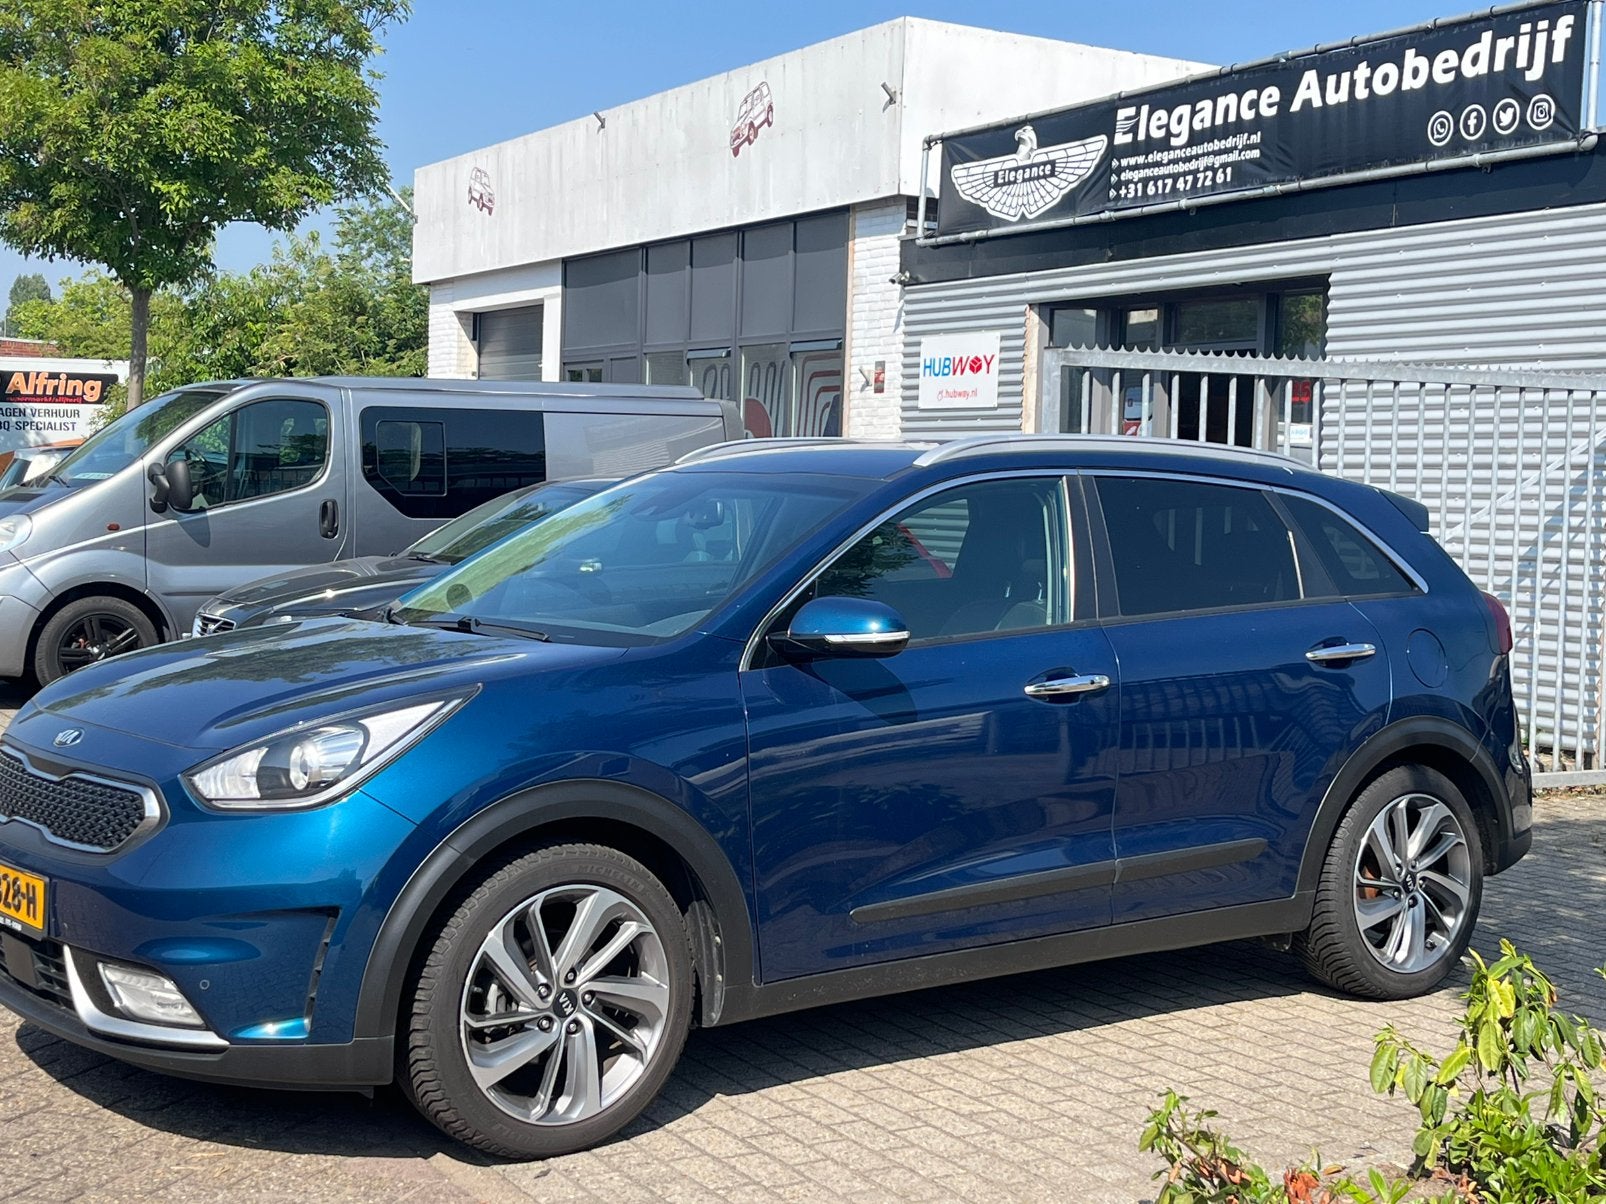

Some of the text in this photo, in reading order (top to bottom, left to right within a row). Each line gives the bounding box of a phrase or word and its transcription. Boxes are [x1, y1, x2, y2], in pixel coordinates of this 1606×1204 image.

[1114, 14, 1575, 146] Elegance Autobedrijf
[1120, 131, 1261, 167] www.eleganceautobedrijf.nl
[997, 164, 1052, 184] Elegance
[1120, 149, 1260, 182] eleganceautobedrijf@gmail.com
[1119, 166, 1232, 198] +31 617 47 72 61
[5, 371, 102, 402] Alfring
[30, 409, 80, 418] VERHUUR
[0, 873, 37, 921] 28-H
[559, 992, 574, 1015] KIA
